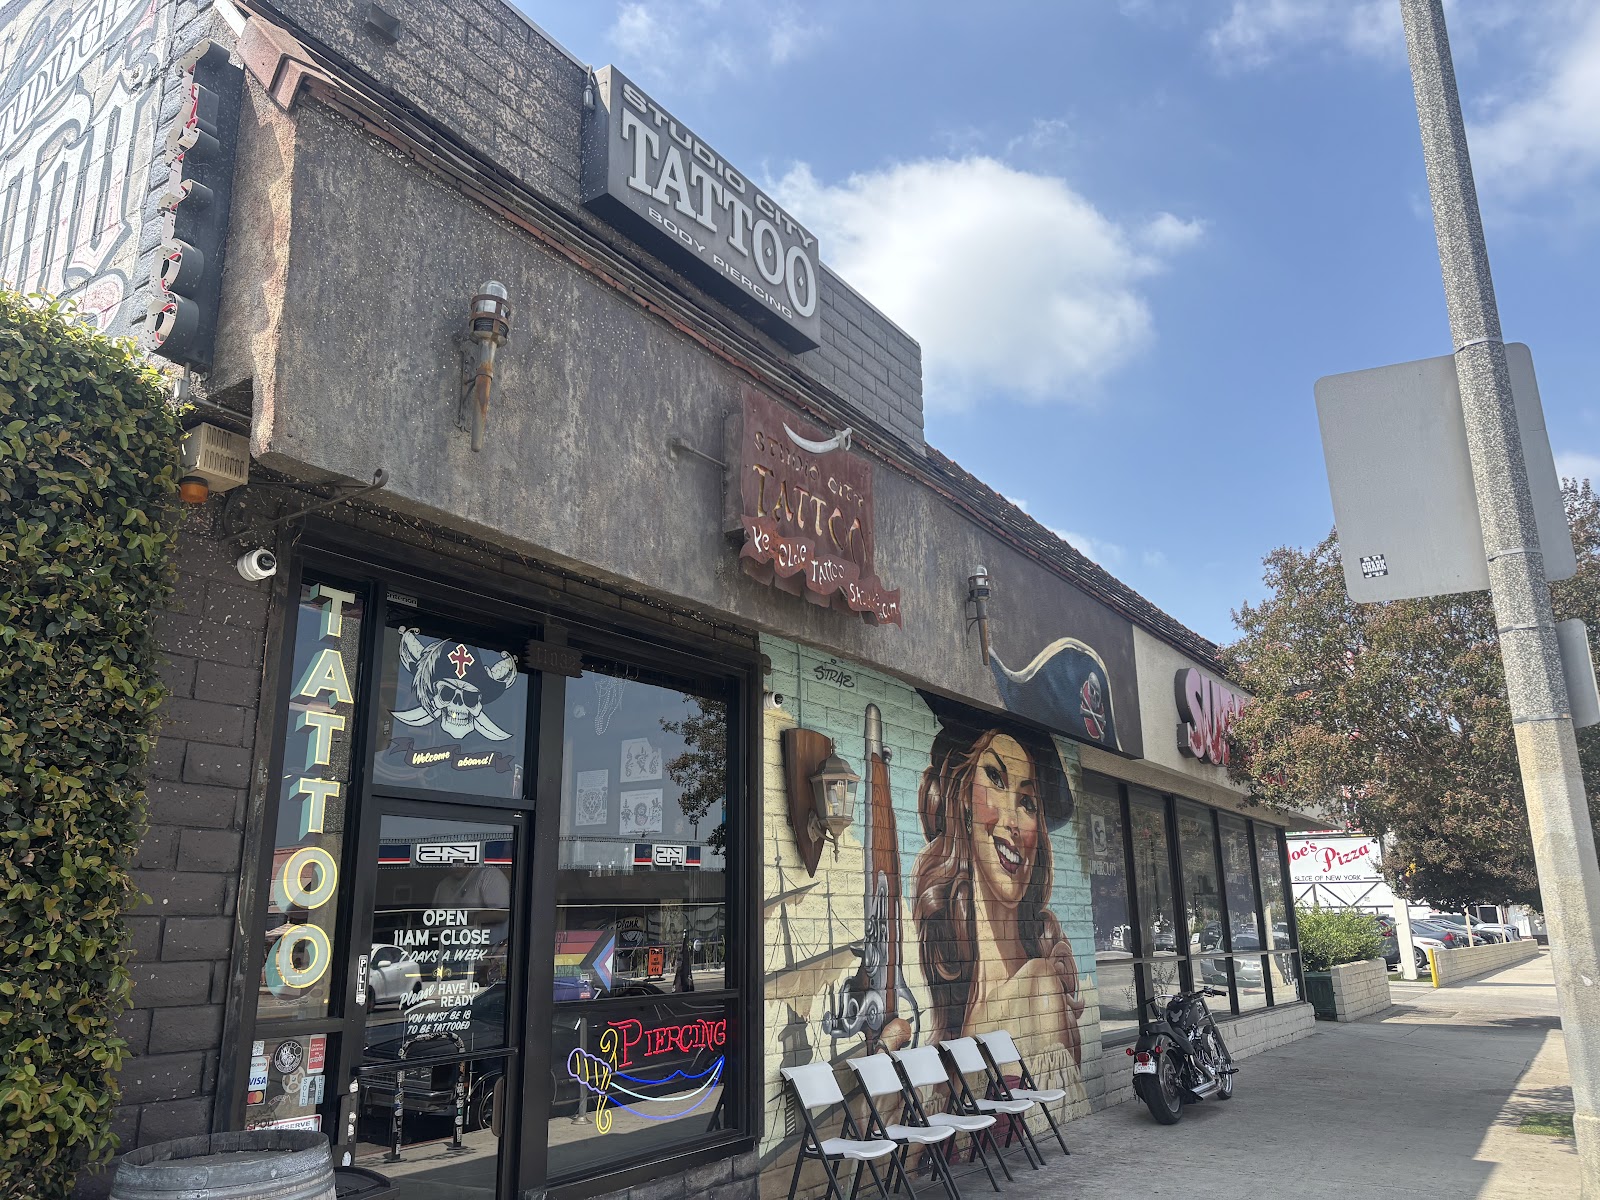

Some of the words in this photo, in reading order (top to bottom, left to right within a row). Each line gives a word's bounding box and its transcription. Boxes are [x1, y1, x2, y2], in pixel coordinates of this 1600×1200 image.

[0, 36, 76, 150] TUDIO
[622, 83, 746, 195] STUDIO
[755, 193, 815, 249] CITY
[620, 107, 817, 318] TATTOO
[648, 206, 706, 253] BODY
[712, 253, 793, 320] PIERCING
[752, 464, 868, 565] TATTOO
[752, 525, 770, 553] Ye
[412, 751, 451, 765] Welcome
[457, 752, 495, 767] aboard!
[269, 583, 356, 993] TATTOO
[1315, 844, 1370, 873] Pizza
[422, 910, 468, 926] OPEN
[393, 929, 430, 946] 11AM
[440, 928, 491, 946] CLOSE
[400, 951, 409, 964] 7
[408, 950, 440, 963] DAYS
[441, 950, 451, 962] A
[453, 949, 488, 961] WEEK
[358, 959, 367, 993] PULL
[438, 982, 466, 996] HAVE
[469, 982, 480, 993] ID
[440, 994, 476, 1008] READY
[407, 1013, 425, 1024] YOU
[425, 1011, 449, 1022] MUST
[449, 1010, 461, 1020] BE
[462, 1009, 472, 1020] 18
[407, 1024, 419, 1035] TO
[420, 1023, 432, 1034] BE
[432, 1020, 471, 1033] TATTOOED
[607, 1018, 727, 1068] PIERCING
[249, 1076, 267, 1087] VISA
